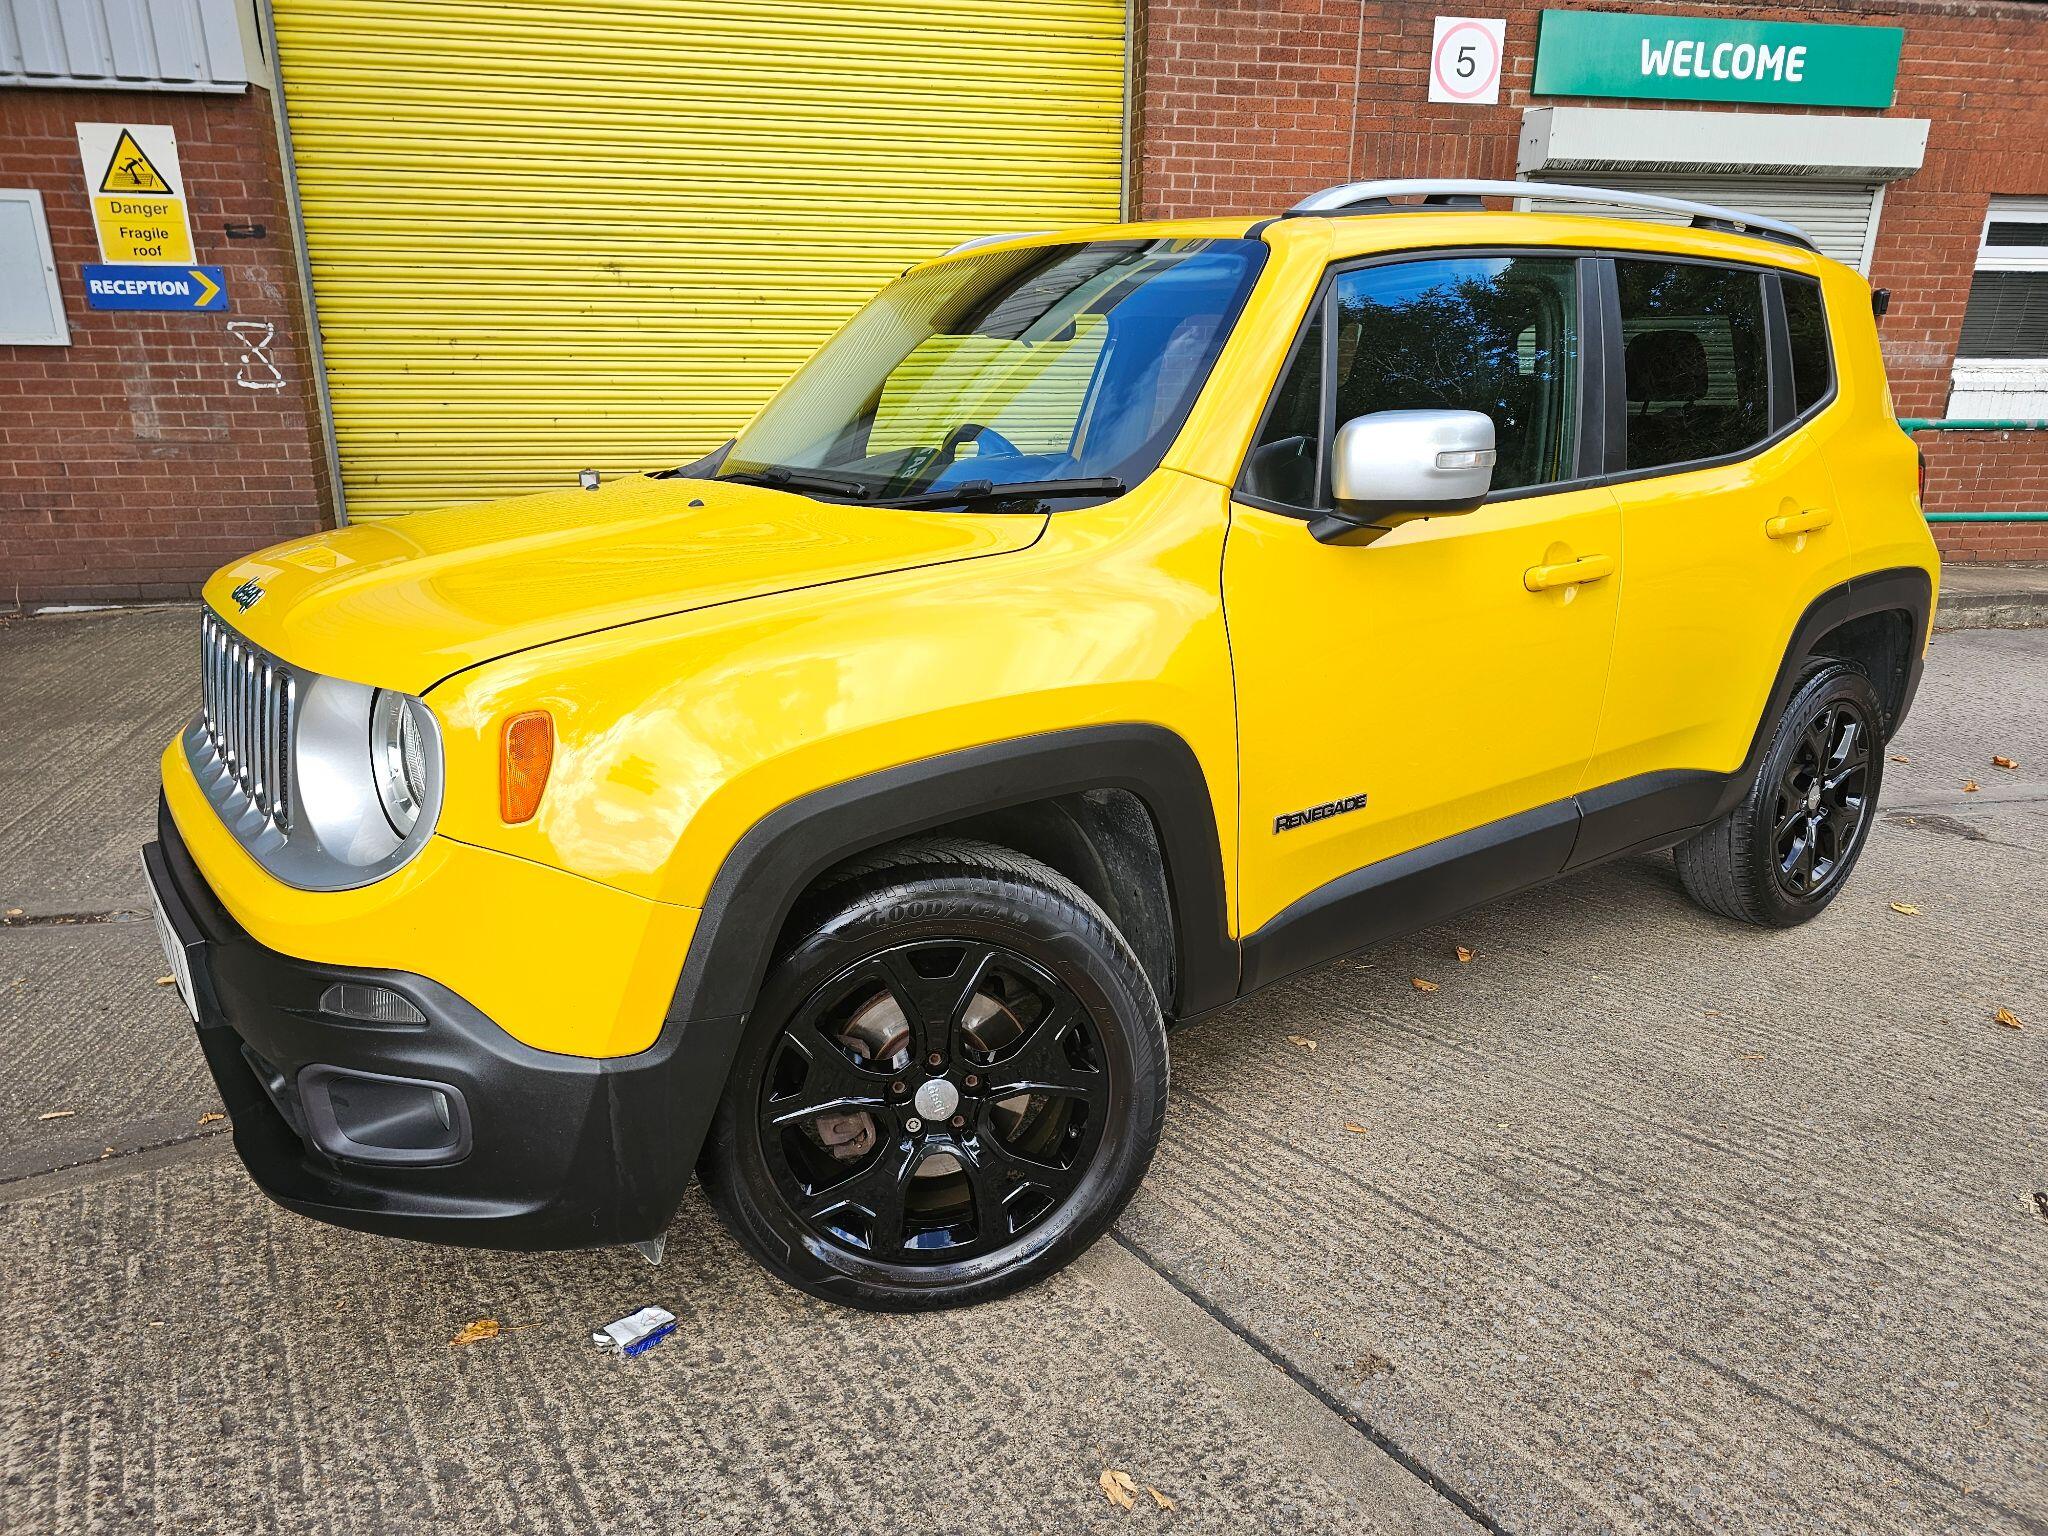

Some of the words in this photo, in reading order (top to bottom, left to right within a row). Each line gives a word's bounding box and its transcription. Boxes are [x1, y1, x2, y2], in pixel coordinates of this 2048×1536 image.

[1456, 46, 1476, 77] 5
[1641, 38, 1807, 82] WELCOME
[110, 201, 168, 217] Danger
[119, 227, 169, 242] Fragile
[133, 245, 162, 257] roof
[90, 279, 190, 296] RECEPTION
[1272, 792, 1368, 835] RENEGADE
